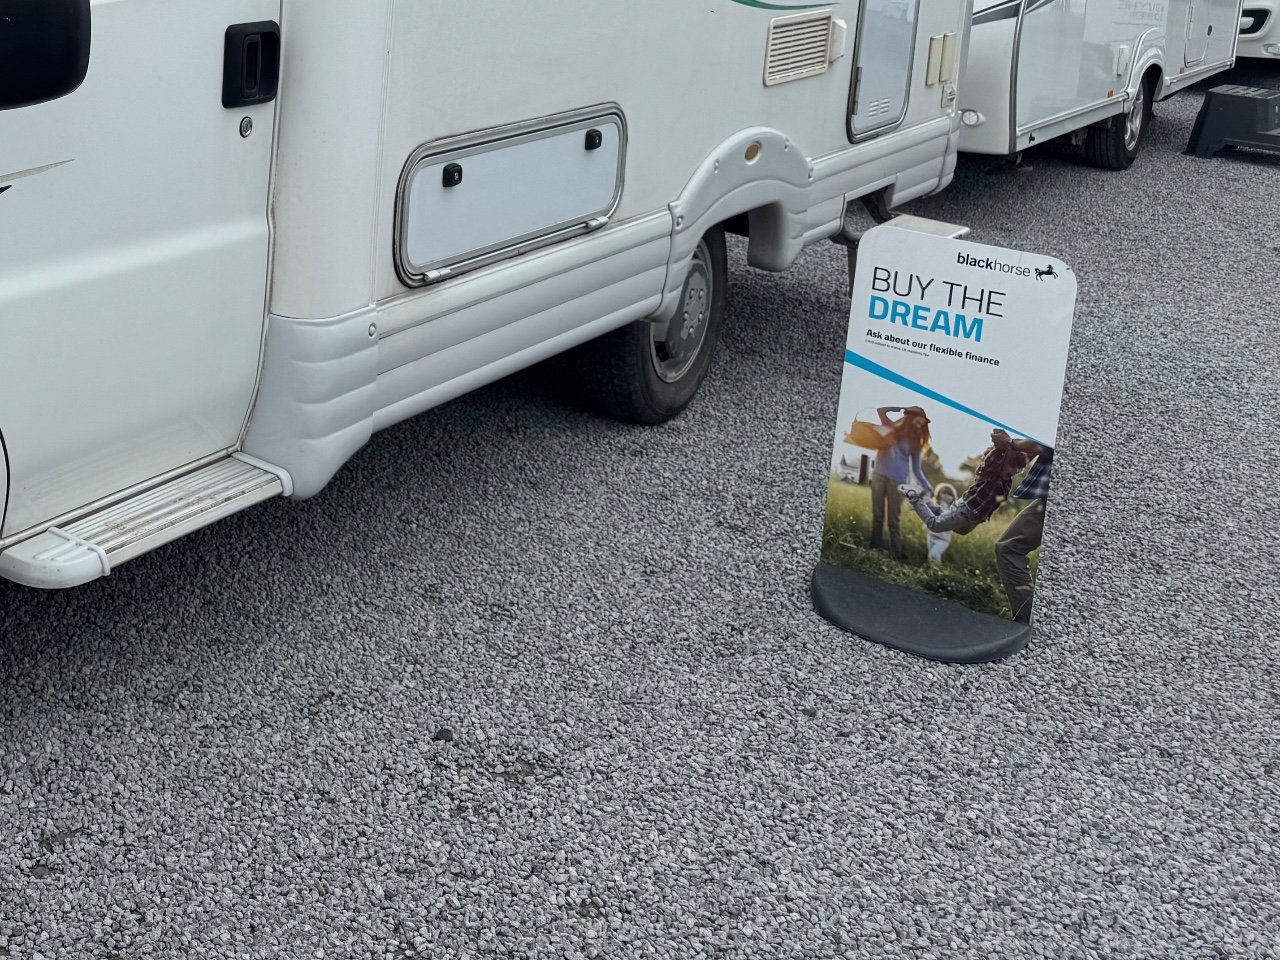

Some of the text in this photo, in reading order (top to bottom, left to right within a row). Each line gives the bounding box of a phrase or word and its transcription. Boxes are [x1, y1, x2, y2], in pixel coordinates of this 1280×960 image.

[956, 251, 1031, 277] blackhorse
[871, 266, 1006, 317] BUY THE
[868, 294, 983, 342] DREAM
[866, 329, 882, 340] Ask
[884, 333, 910, 346] about
[912, 340, 927, 350] our
[929, 343, 963, 358] flexible
[965, 351, 1000, 367] finance
